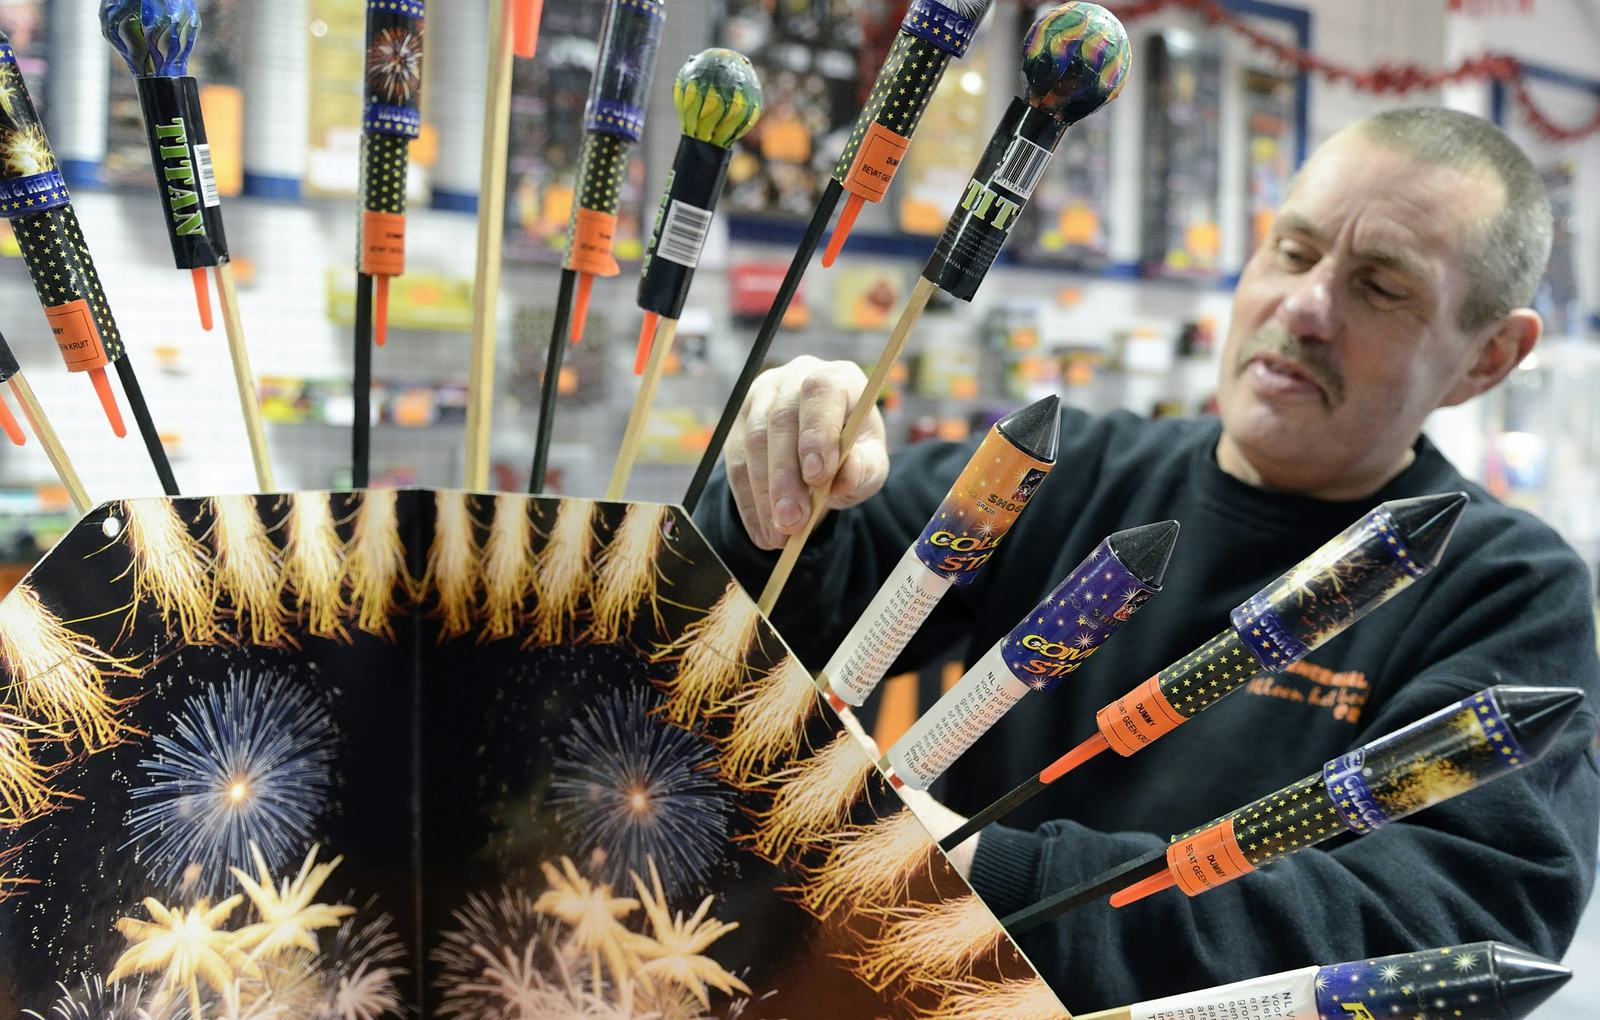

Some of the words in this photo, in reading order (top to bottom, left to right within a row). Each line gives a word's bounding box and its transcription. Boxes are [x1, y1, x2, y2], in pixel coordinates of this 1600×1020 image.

[25, 176, 52, 194] RED
[156, 117, 206, 236] TITAN
[987, 671, 995, 686] NL
[1122, 715, 1138, 735] GEEN
[1136, 702, 1157, 727] DUMMY
[1250, 998, 1259, 1012] en
[1261, 995, 1272, 1018] Niet
[1272, 993, 1282, 1017] voor
